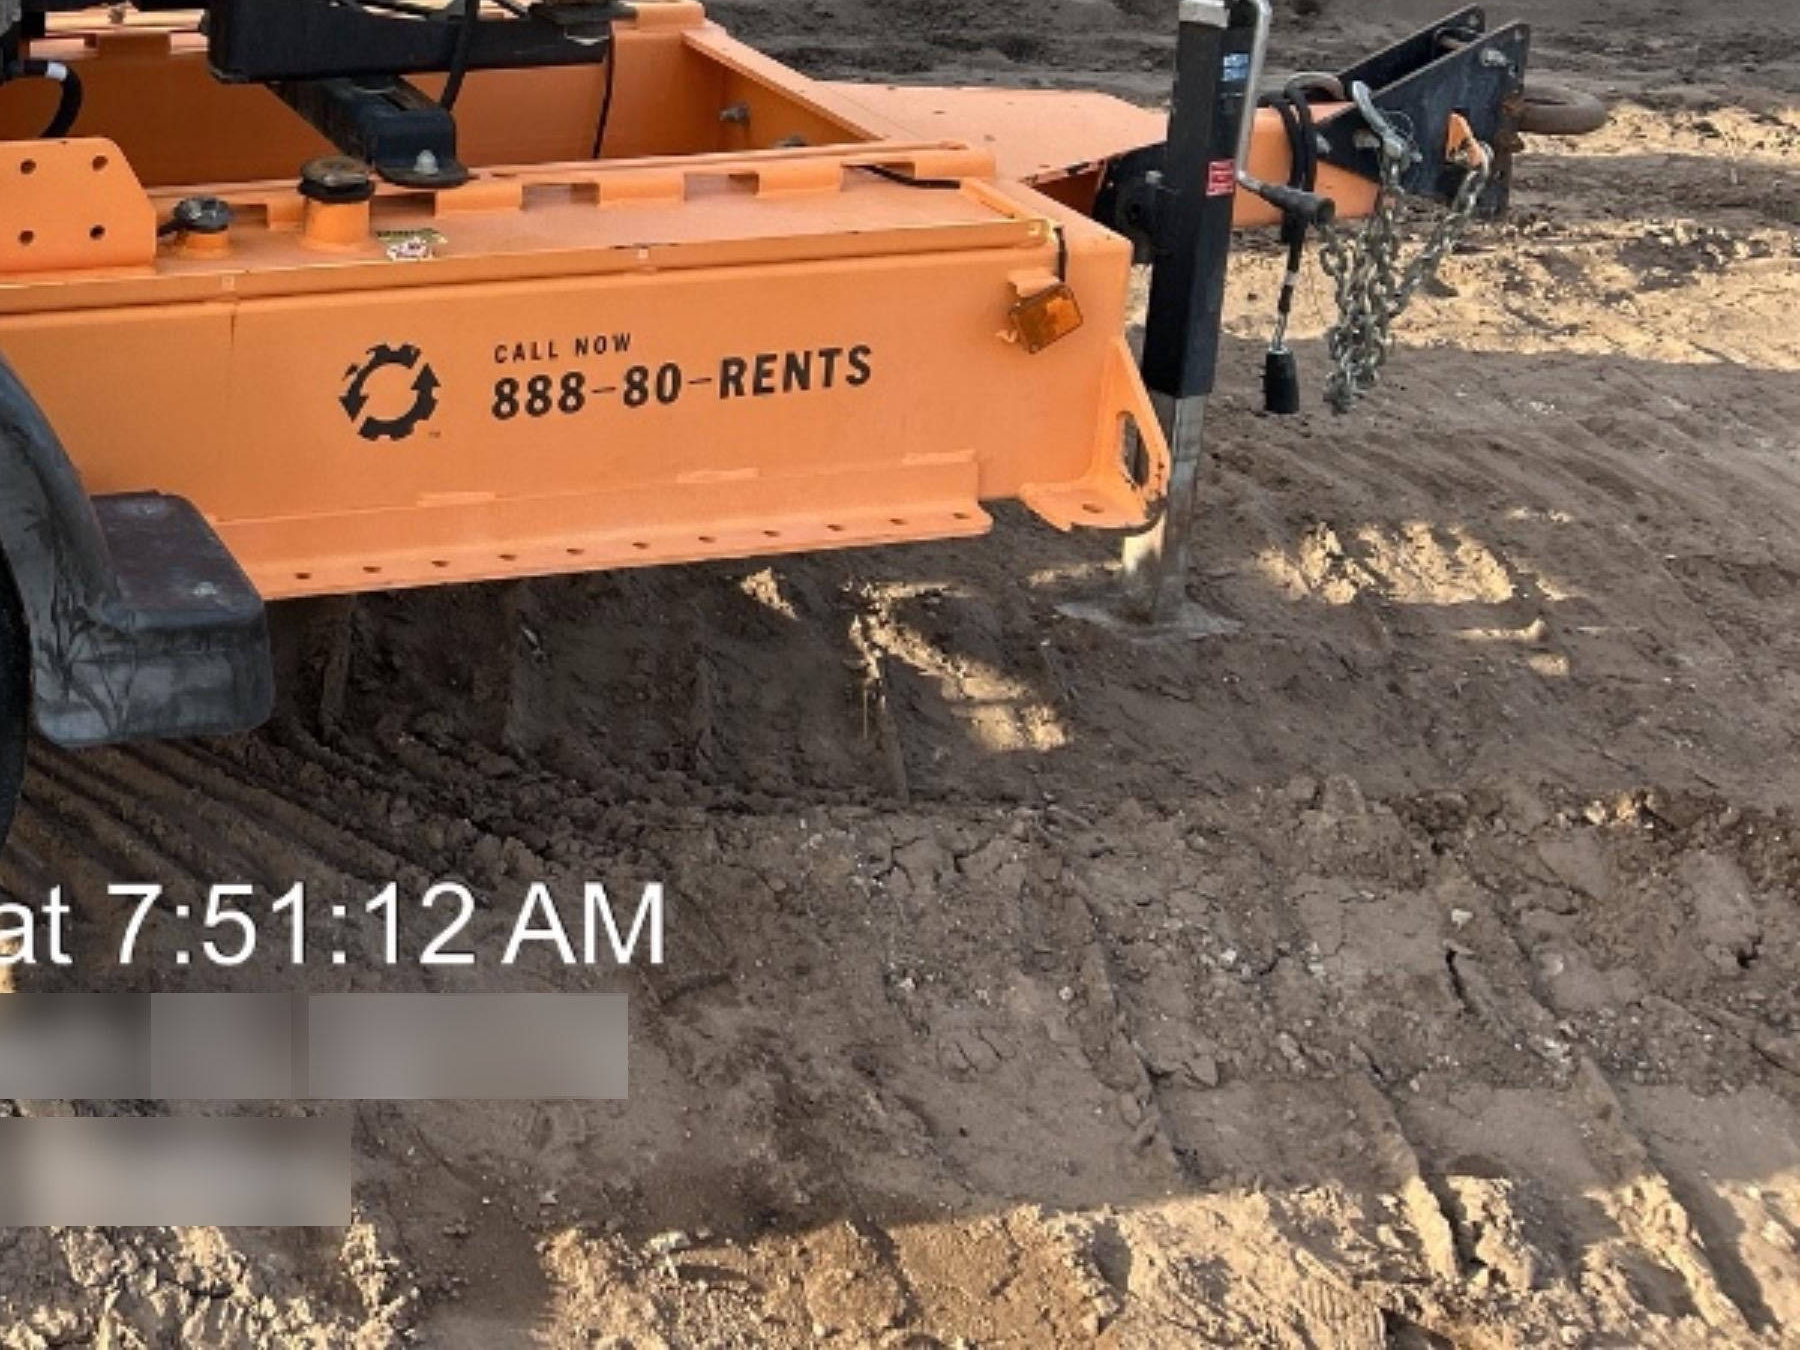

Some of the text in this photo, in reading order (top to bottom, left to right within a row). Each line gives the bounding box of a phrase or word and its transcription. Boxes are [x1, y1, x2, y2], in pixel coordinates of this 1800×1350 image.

[494, 332, 632, 364] CALL NOW
[490, 344, 874, 421] 888-80-RENTS
